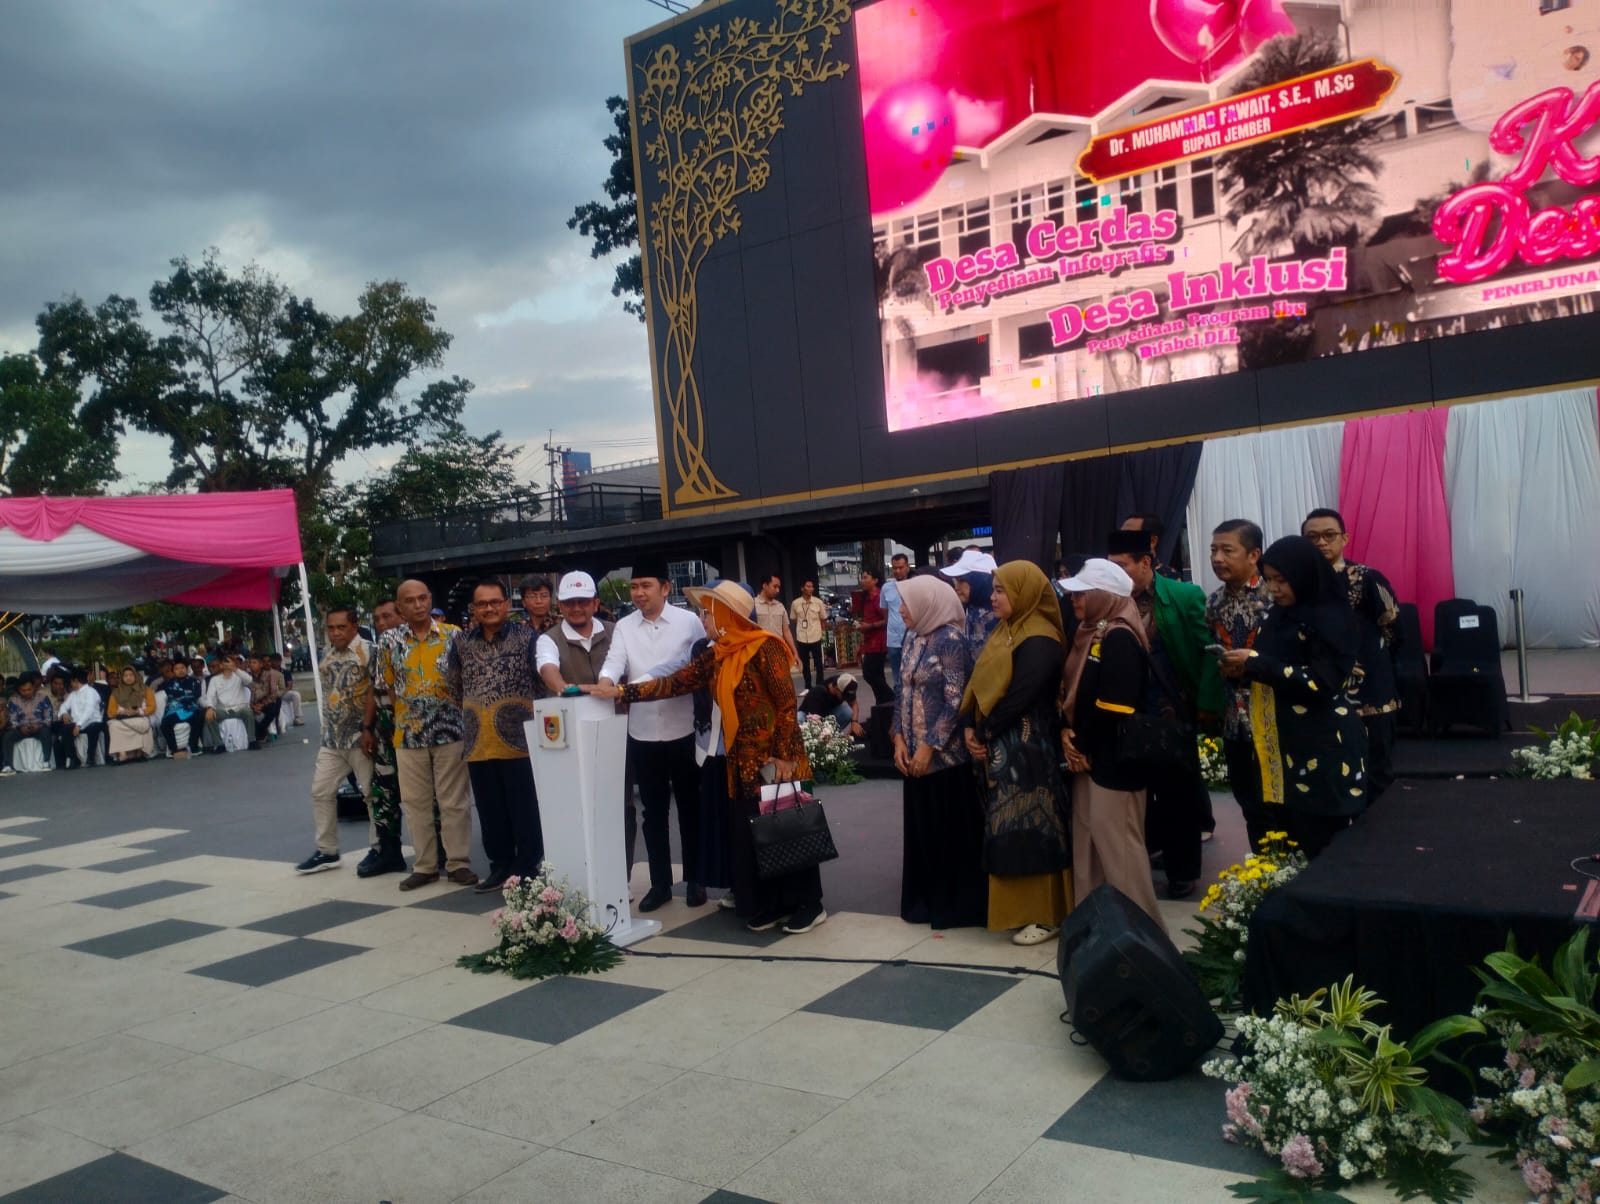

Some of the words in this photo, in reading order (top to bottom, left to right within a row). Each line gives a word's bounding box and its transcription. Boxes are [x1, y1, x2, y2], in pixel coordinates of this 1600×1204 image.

[1109, 136, 1130, 156] Dr.
[1131, 112, 1217, 152] MUHAMMAD
[1219, 94, 1277, 125] FAWAIT,
[1278, 91, 1312, 109] S.E.,
[1314, 73, 1355, 99] M.Sc
[1182, 133, 1222, 155] BUPATI
[1223, 118, 1272, 144] JEMBER
[924, 241, 1018, 294] Desa
[1025, 205, 1178, 258] Cerdas
[938, 263, 1055, 310] Penyediaan
[1058, 241, 1168, 277] Infografis
[1048, 288, 1158, 346] Desa
[1167, 247, 1347, 311] Inklusi
[1482, 269, 1600, 302] PENERJUNA
[1086, 318, 1185, 354] Penyediaan
[1187, 304, 1270, 331] Program
